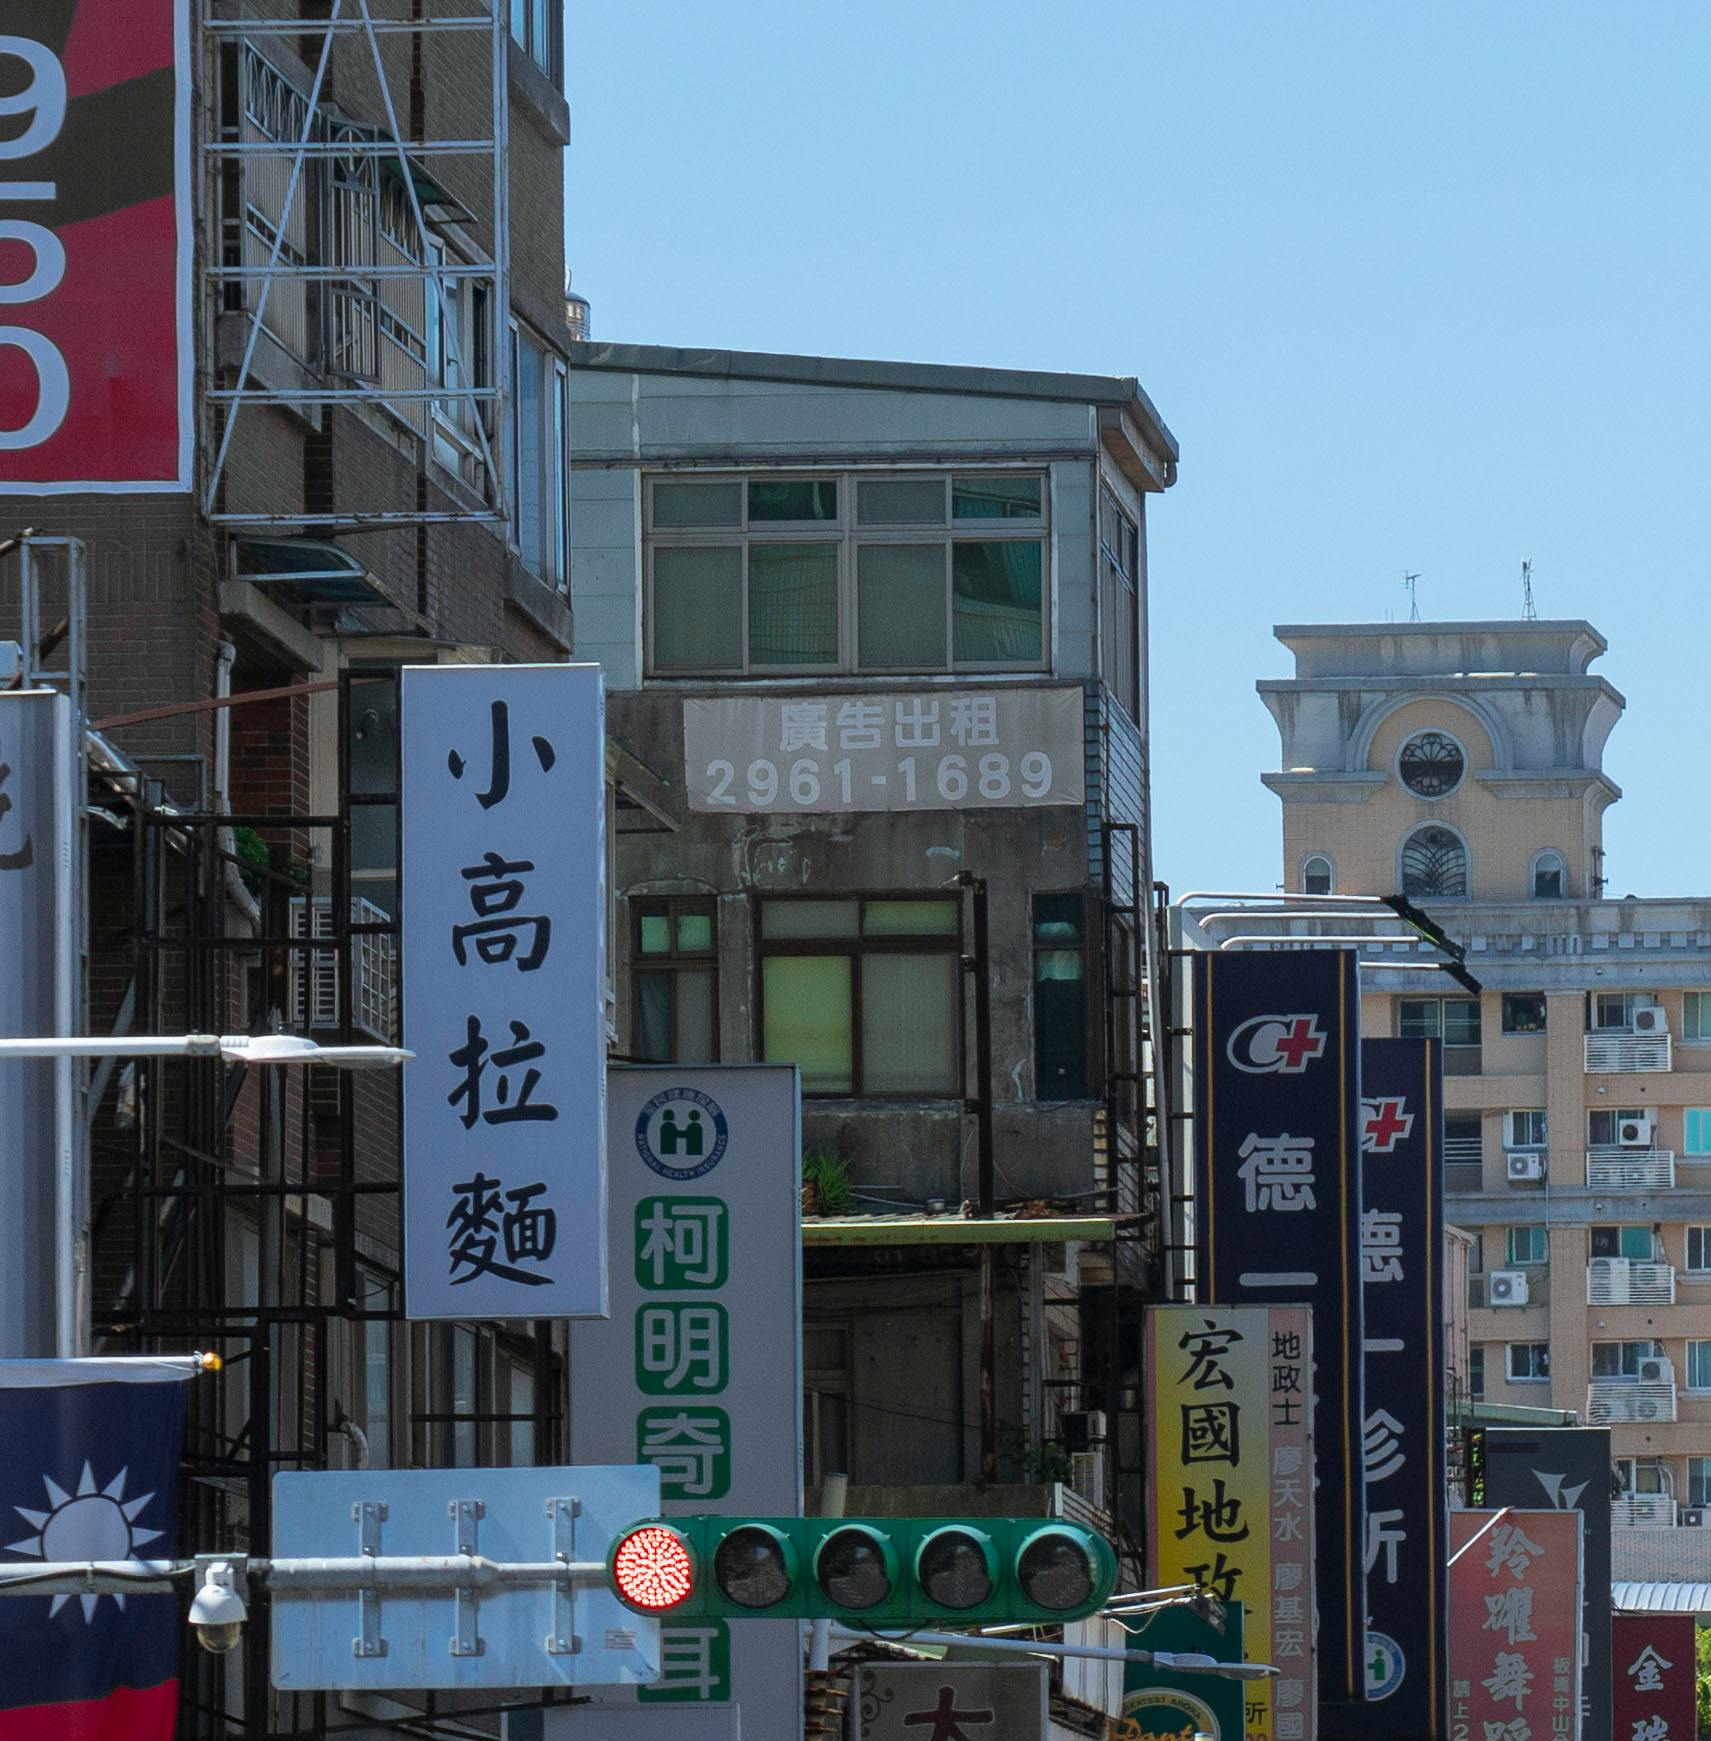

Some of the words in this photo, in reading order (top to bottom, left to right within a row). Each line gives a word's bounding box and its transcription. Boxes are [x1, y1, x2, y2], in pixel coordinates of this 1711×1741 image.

[779, 697, 1000, 751] 廣告出租
[706, 752, 1053, 804] 2961-1689
[446, 700, 559, 1287] 小高拉麵
[1271, 1331, 1302, 1426] 地政士
[1272, 1446, 1304, 1542] 廖天水
[1274, 1562, 1305, 1657] 廖基宏
